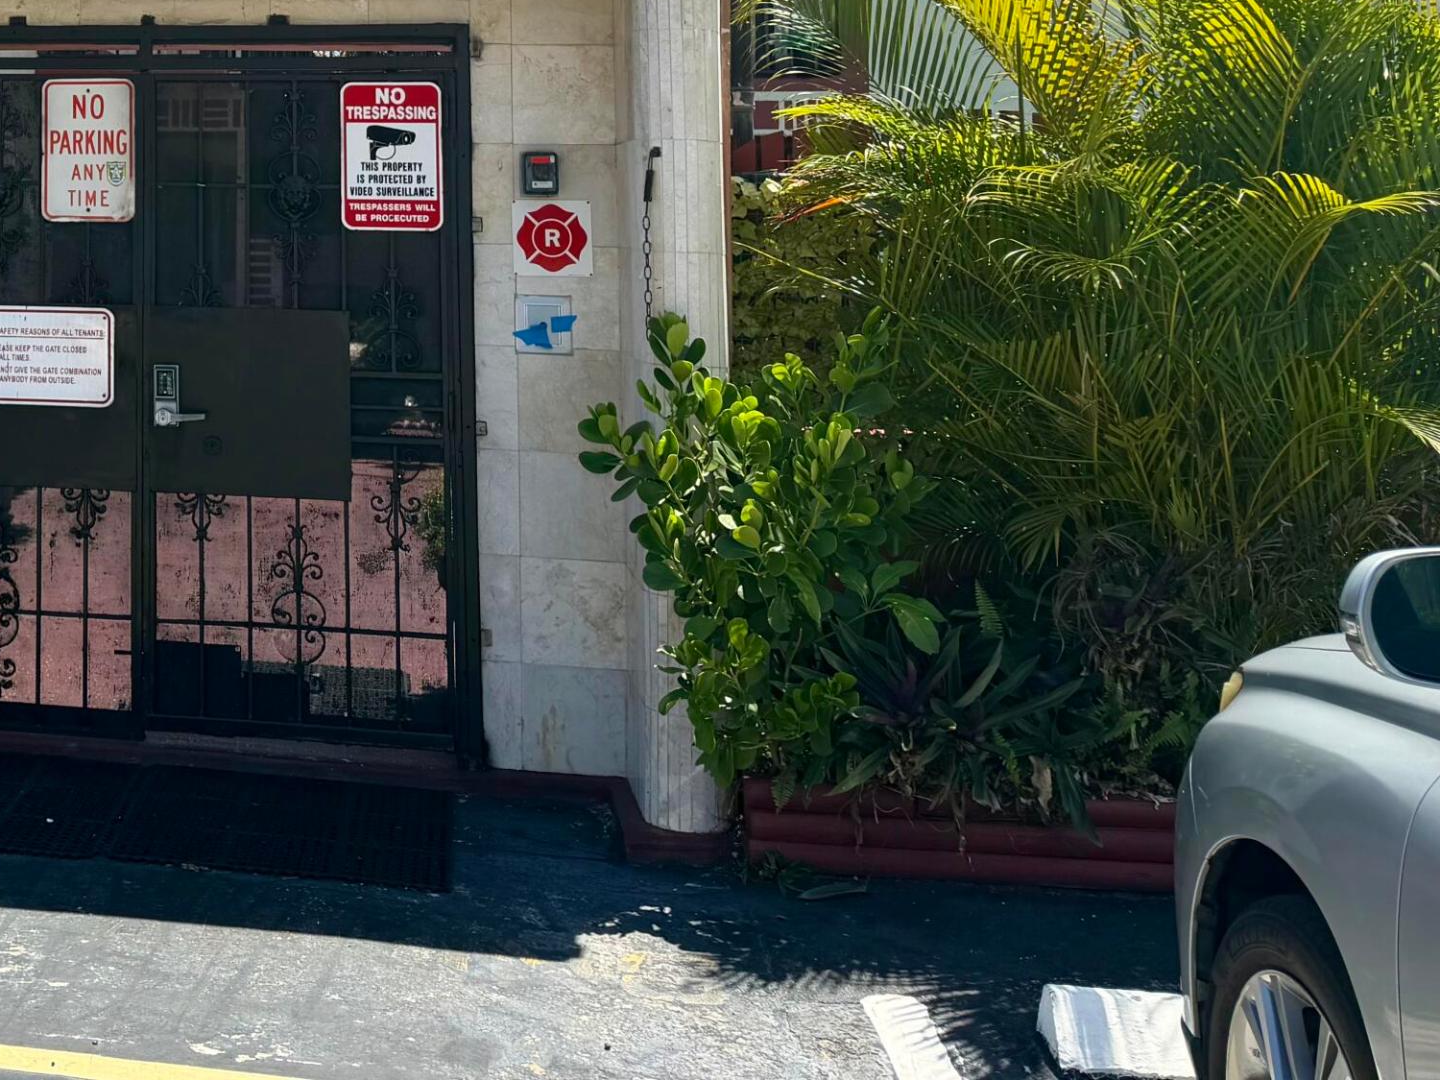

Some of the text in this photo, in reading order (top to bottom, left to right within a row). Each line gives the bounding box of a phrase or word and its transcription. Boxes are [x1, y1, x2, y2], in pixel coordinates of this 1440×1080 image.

[375, 87, 406, 105] NO
[72, 94, 105, 119] NO
[346, 106, 437, 120] TRESPASSING
[50, 129, 128, 155] PARKING
[71, 163, 106, 181] ANY
[360, 162, 423, 172] THIS PROPERTY
[356, 174, 427, 184] IS PROTECTED BY
[349, 186, 435, 197] VIDEO SURVEILLANCE
[68, 189, 110, 207] TIME
[349, 203, 436, 212] TRESPASSERS WILL
[355, 214, 367, 222] BE
[544, 228, 561, 248] R
[20, 328, 50, 336] REASONS
[62, 346, 88, 354] CLOSED
[0, 353, 10, 361] ALL
[14, 366, 29, 374] GIVE
[42, 367, 59, 375] GATE
[60, 367, 102, 376] COMBINATION
[0, 375, 29, 383] ANYBODY
[29, 376, 47, 384] FROM
